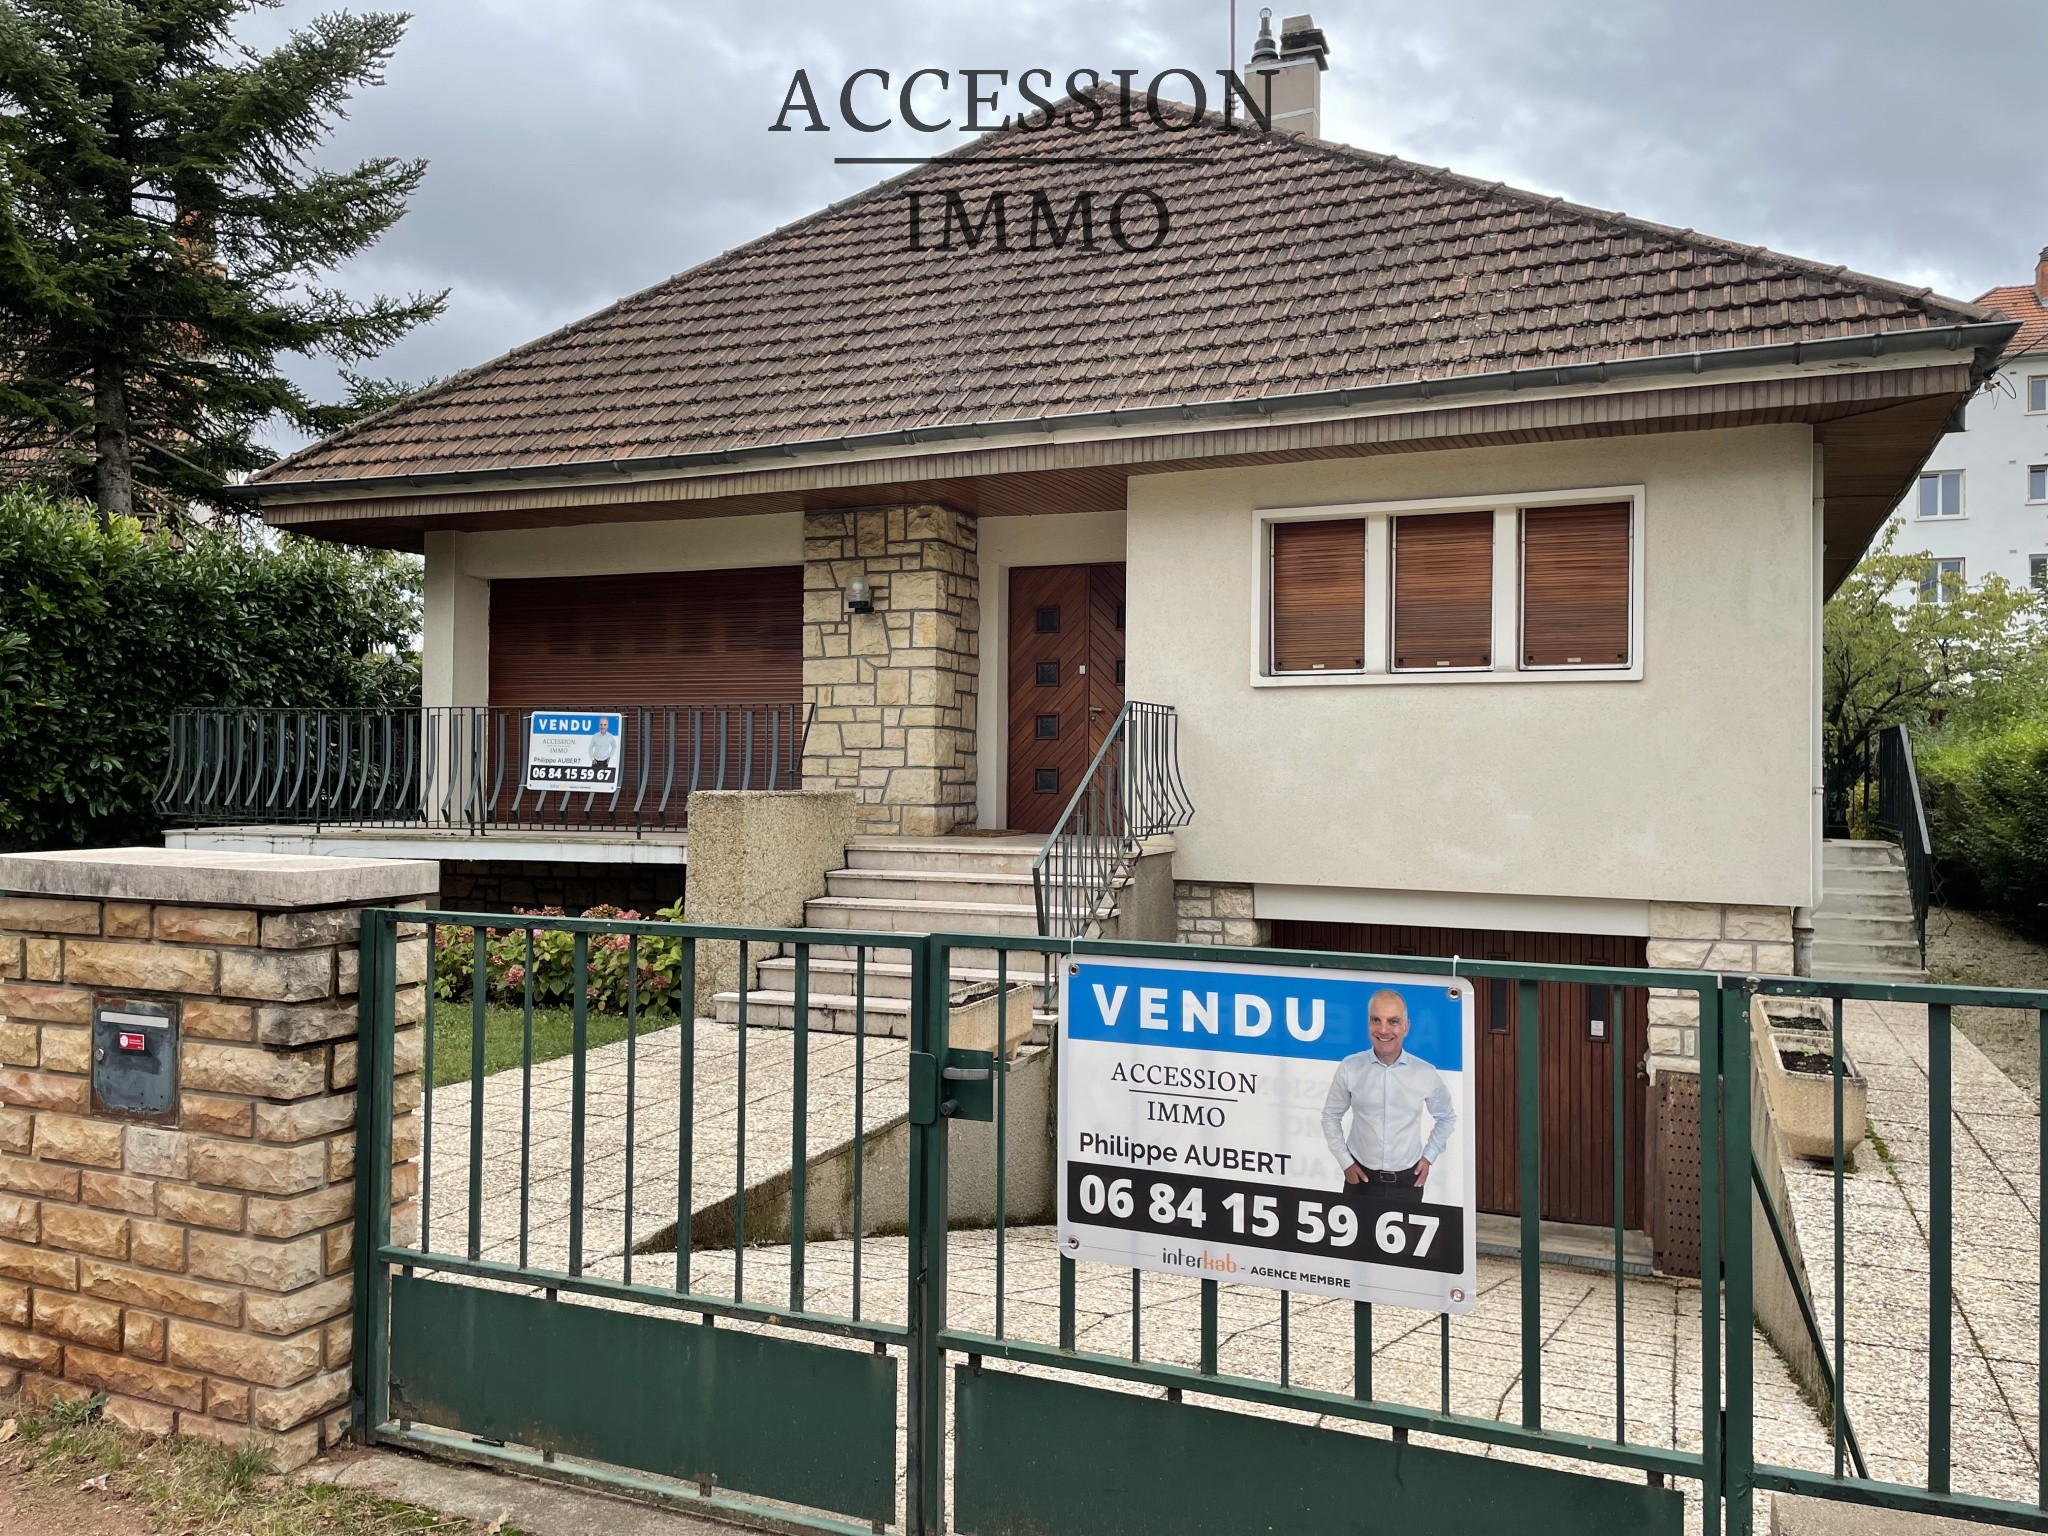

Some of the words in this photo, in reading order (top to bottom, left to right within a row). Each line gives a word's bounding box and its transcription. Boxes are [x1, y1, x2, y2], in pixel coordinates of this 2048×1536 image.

[539, 719, 592, 731] VENDU
[532, 767, 546, 778] 06
[548, 768, 562, 779] 84
[564, 768, 578, 780] 15
[580, 769, 595, 780] 59
[597, 769, 612, 781] 67
[1091, 983, 1326, 1042] VENDU
[1111, 1062, 1258, 1094] ACCESSION
[1147, 1101, 1226, 1128] IMMO
[1080, 1132, 1178, 1165] Philippe
[1184, 1144, 1292, 1175] AUBERT
[1079, 1174, 1134, 1219] 06
[1149, 1183, 1207, 1229] 84
[1221, 1192, 1280, 1238] 15
[1296, 1202, 1359, 1247] 59
[1375, 1211, 1440, 1258] 67
[1162, 1247, 1237, 1273] interkab
[1250, 1265, 1297, 1281] AGENCE
[1300, 1273, 1351, 1288] MEMBRE
